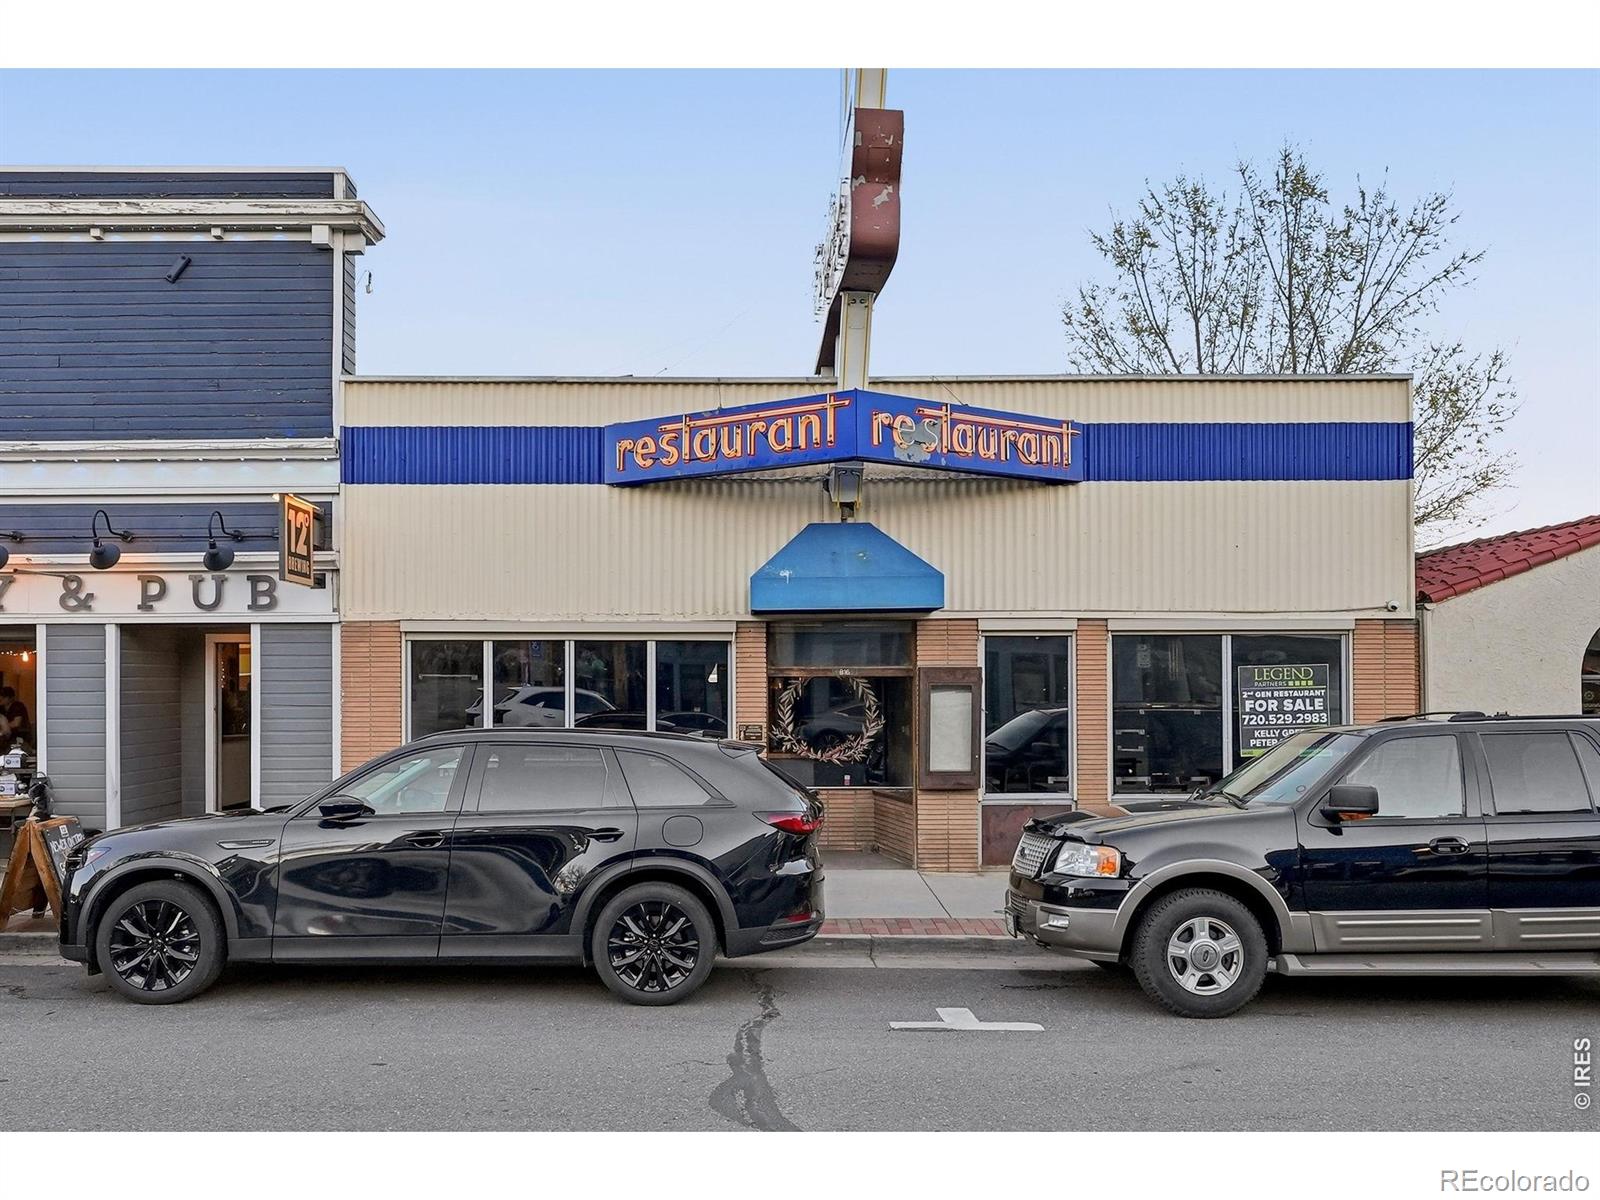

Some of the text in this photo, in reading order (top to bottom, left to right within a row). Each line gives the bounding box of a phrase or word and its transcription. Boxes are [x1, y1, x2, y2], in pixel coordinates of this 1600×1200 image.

[616, 393, 850, 471] restaurant
[872, 403, 1081, 467] restaurant
[59, 574, 94, 611] &
[137, 574, 278, 611] PUB
[1254, 667, 1314, 680] LEGEND
[1245, 698, 1324, 712] FOR SALE
[1242, 712, 1328, 725] 720.529.2983
[1254, 729, 1280, 738] KELLY
